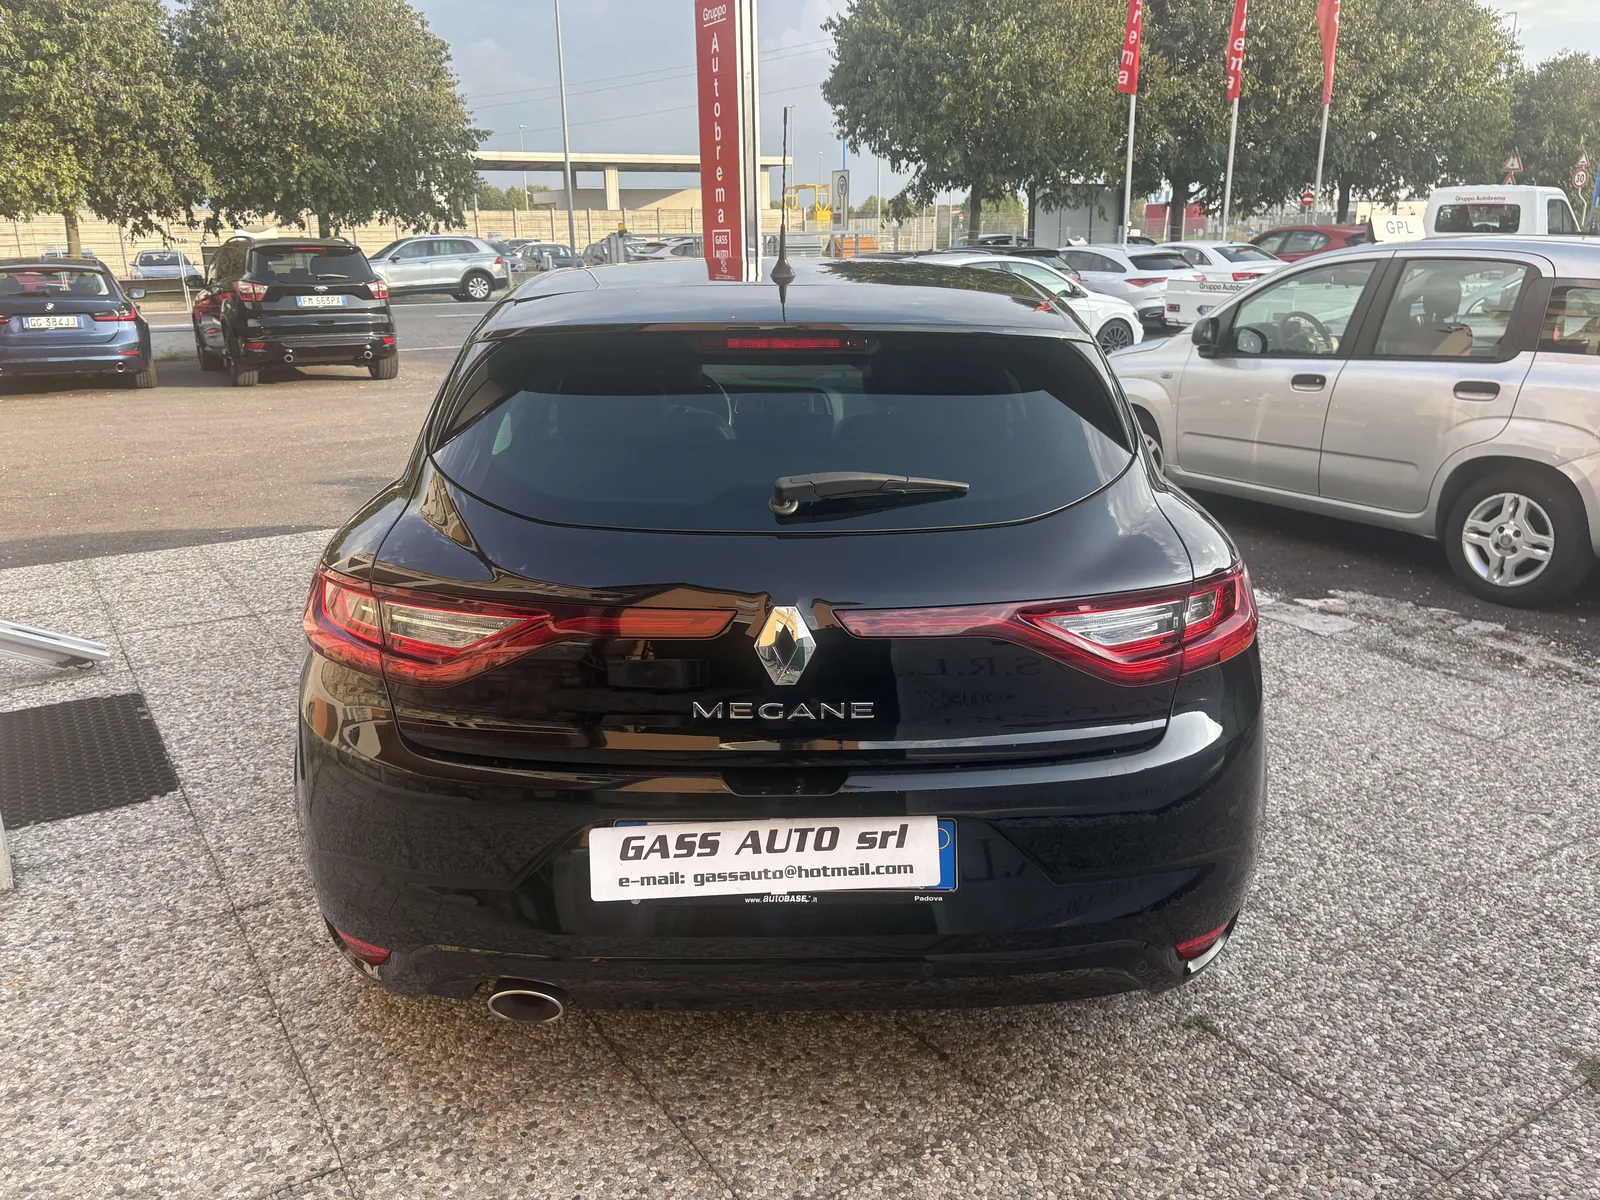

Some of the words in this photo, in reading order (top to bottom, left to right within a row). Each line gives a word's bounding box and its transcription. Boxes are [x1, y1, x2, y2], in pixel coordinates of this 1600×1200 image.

[703, 4, 727, 22] Gruppo
[711, 32, 726, 224] Autobrema
[1575, 174, 1585, 183] 30
[1386, 220, 1413, 234] GPL
[715, 235, 728, 245] GASS
[1199, 282, 1221, 291] Gruppo
[692, 701, 875, 720] MEGANE
[619, 832, 721, 861] GASS
[734, 826, 840, 856] AUTO
[856, 823, 909, 850] srl
[618, 871, 685, 887] e-mail:
[693, 862, 914, 887] gassauto@hotmail.com
